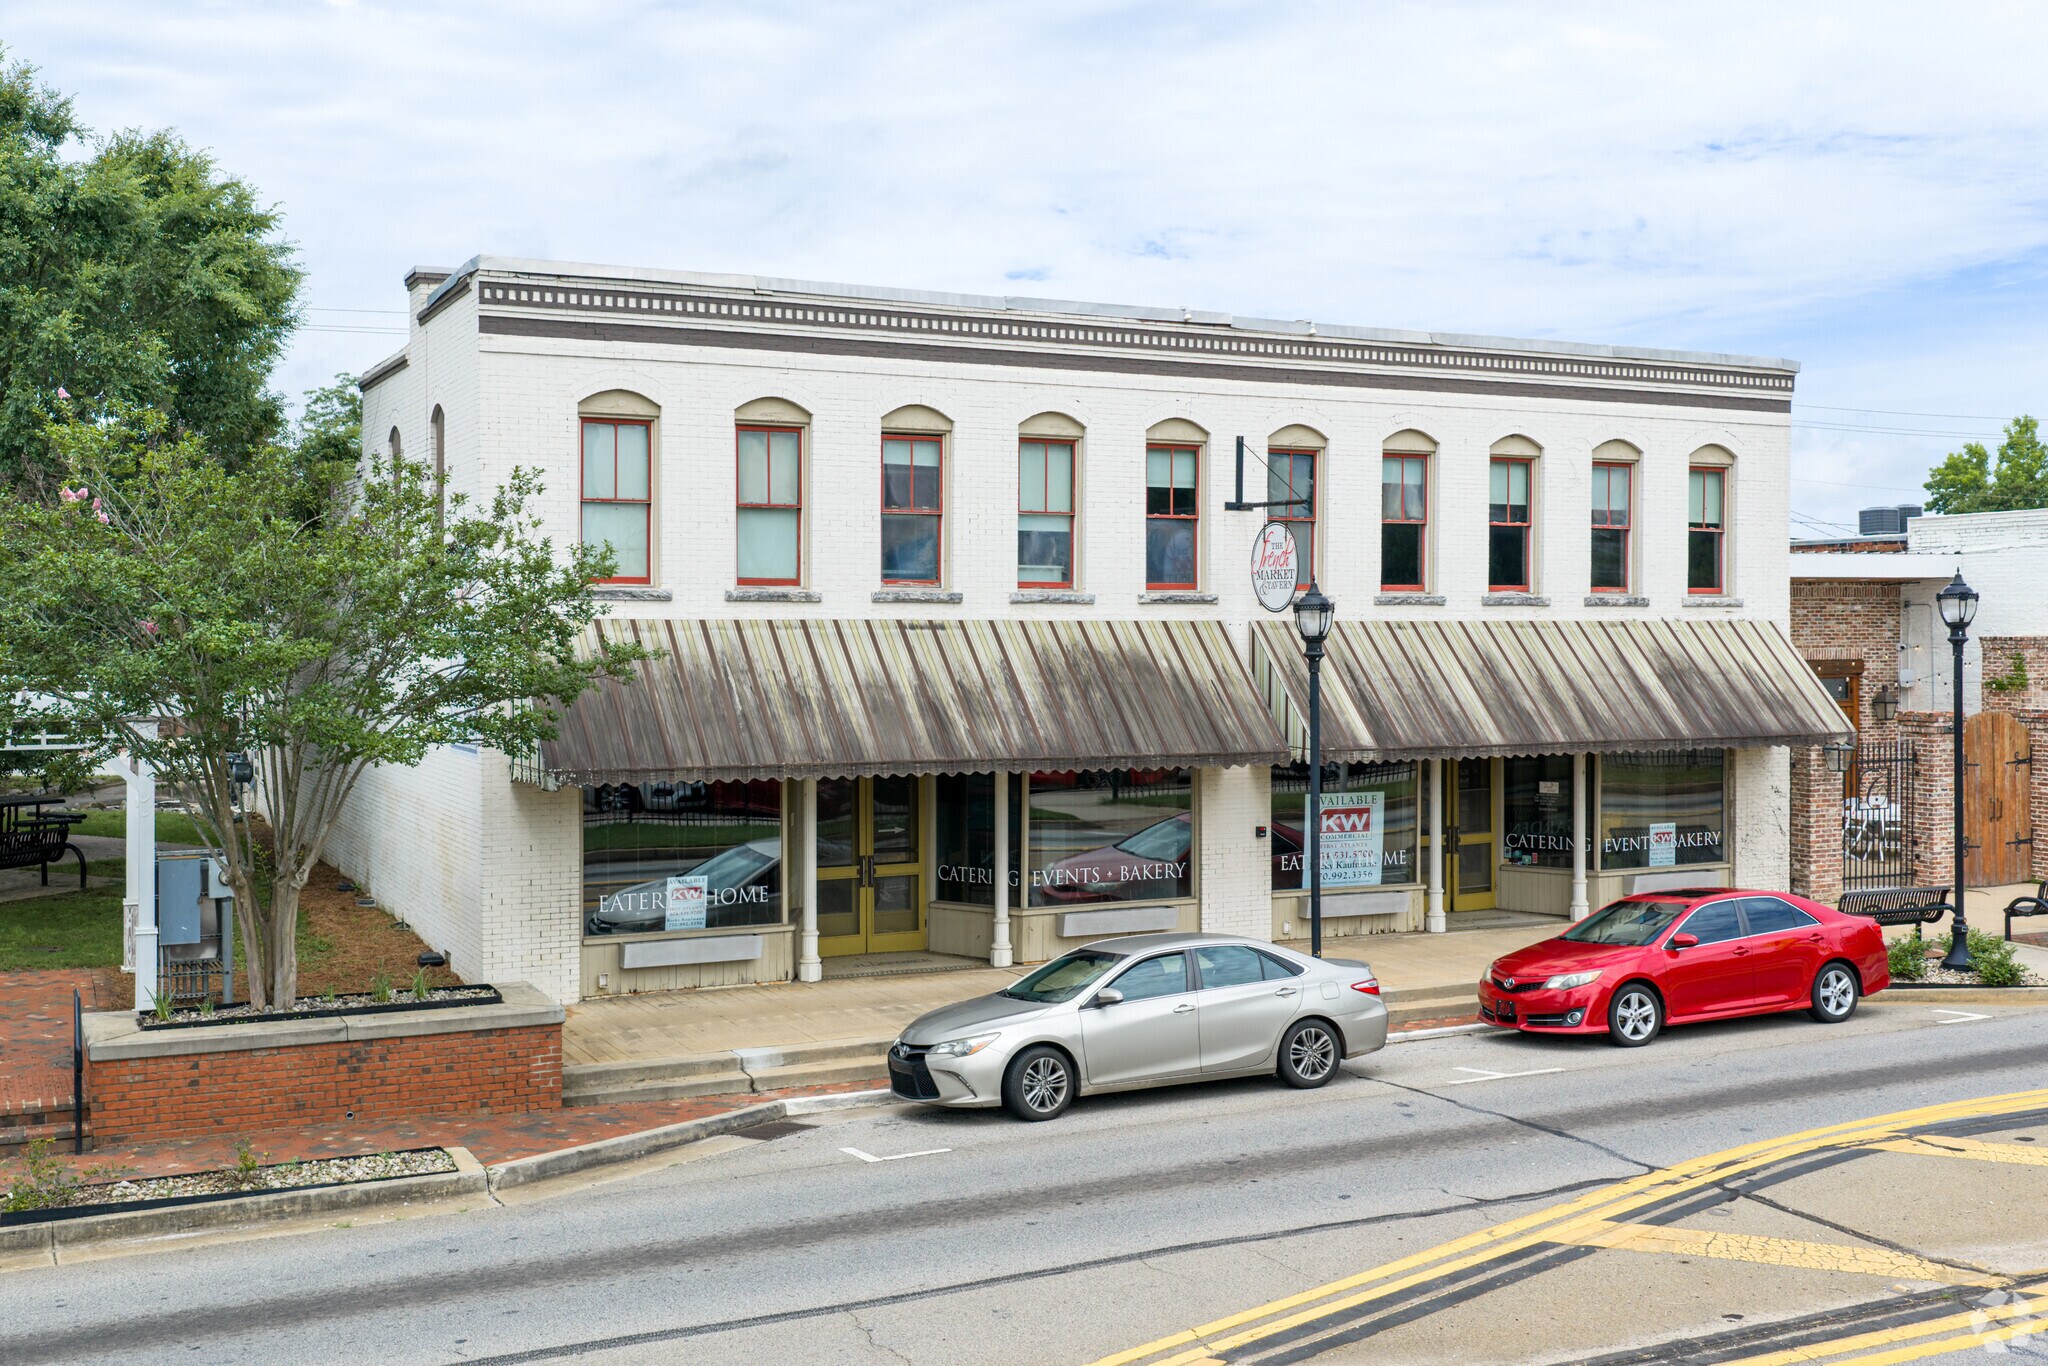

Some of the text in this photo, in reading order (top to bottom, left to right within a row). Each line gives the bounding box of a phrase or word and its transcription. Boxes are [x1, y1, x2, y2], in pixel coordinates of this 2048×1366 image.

[1271, 542, 1283, 550] THE
[1256, 569, 1295, 580] MARKET
[1267, 580, 1293, 590] TAVERN
[1320, 794, 1378, 806] VAILABLE
[1321, 812, 1370, 833] KW
[1604, 831, 1721, 853] EVENTS BAKERY
[938, 865, 1019, 887] CATERIG
[1032, 862, 1187, 887] EVENTS BAKERY
[672, 889, 702, 900] KW
[704, 886, 769, 906] HOME
